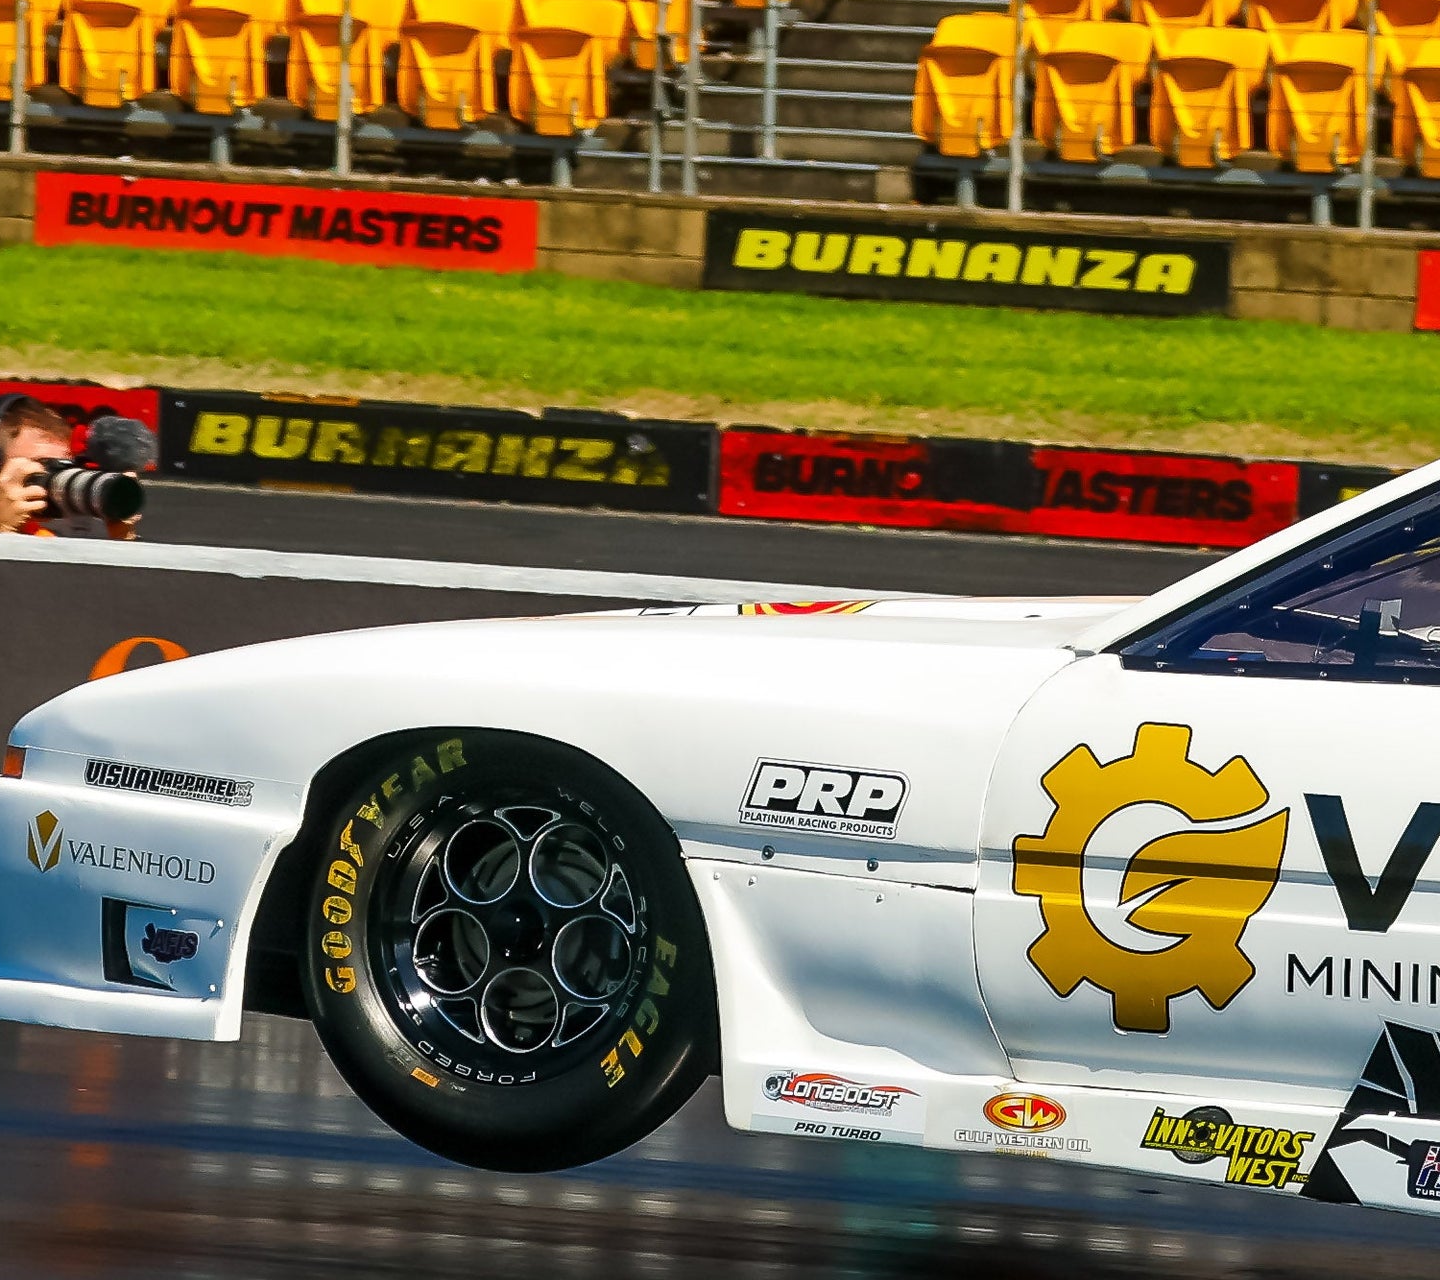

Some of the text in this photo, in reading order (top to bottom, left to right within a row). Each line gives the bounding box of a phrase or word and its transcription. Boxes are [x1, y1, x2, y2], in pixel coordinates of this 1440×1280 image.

[66, 191, 503, 253] BURNOUT MASTERS
[732, 227, 1197, 295] BURNANZA
[87, 761, 160, 793] VISUAL
[159, 773, 237, 797] APPAREL
[750, 765, 903, 818] PRP
[744, 811, 894, 837] PLATINUM RACING PRODUCTS
[68, 839, 216, 885] VALENHOLD
[599, 935, 678, 1089] EAGLE
[780, 1078, 901, 1108] LONGBOOST
[794, 1122, 882, 1141] PRO TURBO
[954, 1129, 1091, 1152] GULF WESTERN OIL
[1227, 1140, 1298, 1187] WEST
